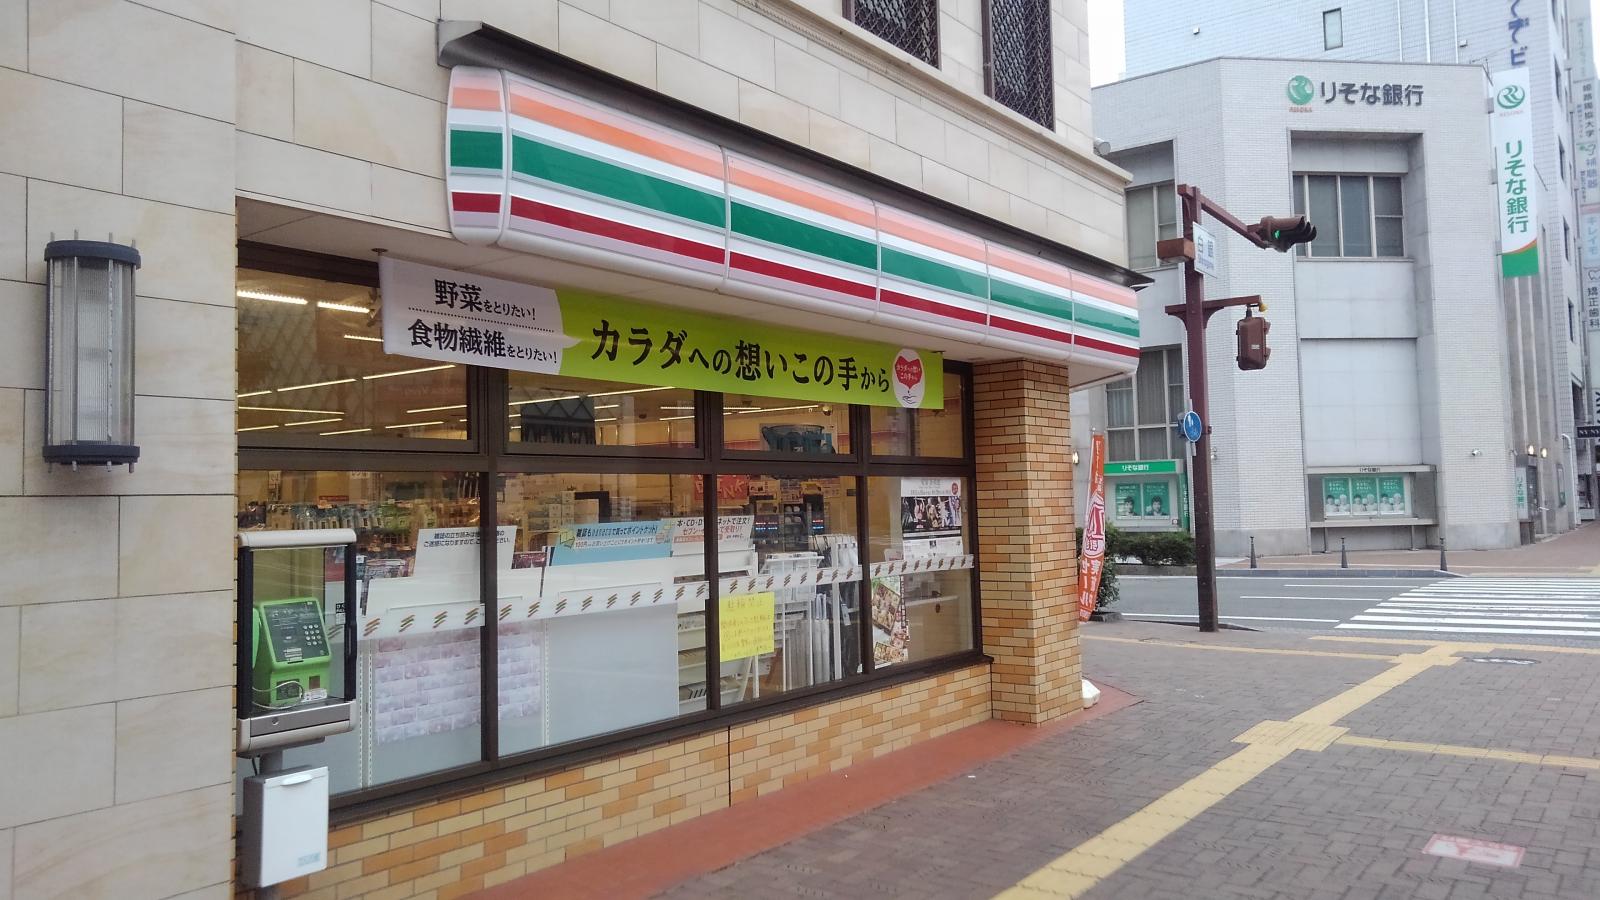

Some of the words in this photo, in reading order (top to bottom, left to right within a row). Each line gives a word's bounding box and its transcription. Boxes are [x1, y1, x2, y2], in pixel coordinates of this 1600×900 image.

[1320, 81, 1424, 106] りそな銀行
[1504, 140, 1529, 234] りそな銀行
[434, 279, 537, 320] 野菜をとりたい!
[407, 318, 558, 363] 食物繊維をとりたい!
[591, 319, 890, 393] カラダへの想いこの手から
[1122, 464, 1149, 472] りそな銀行
